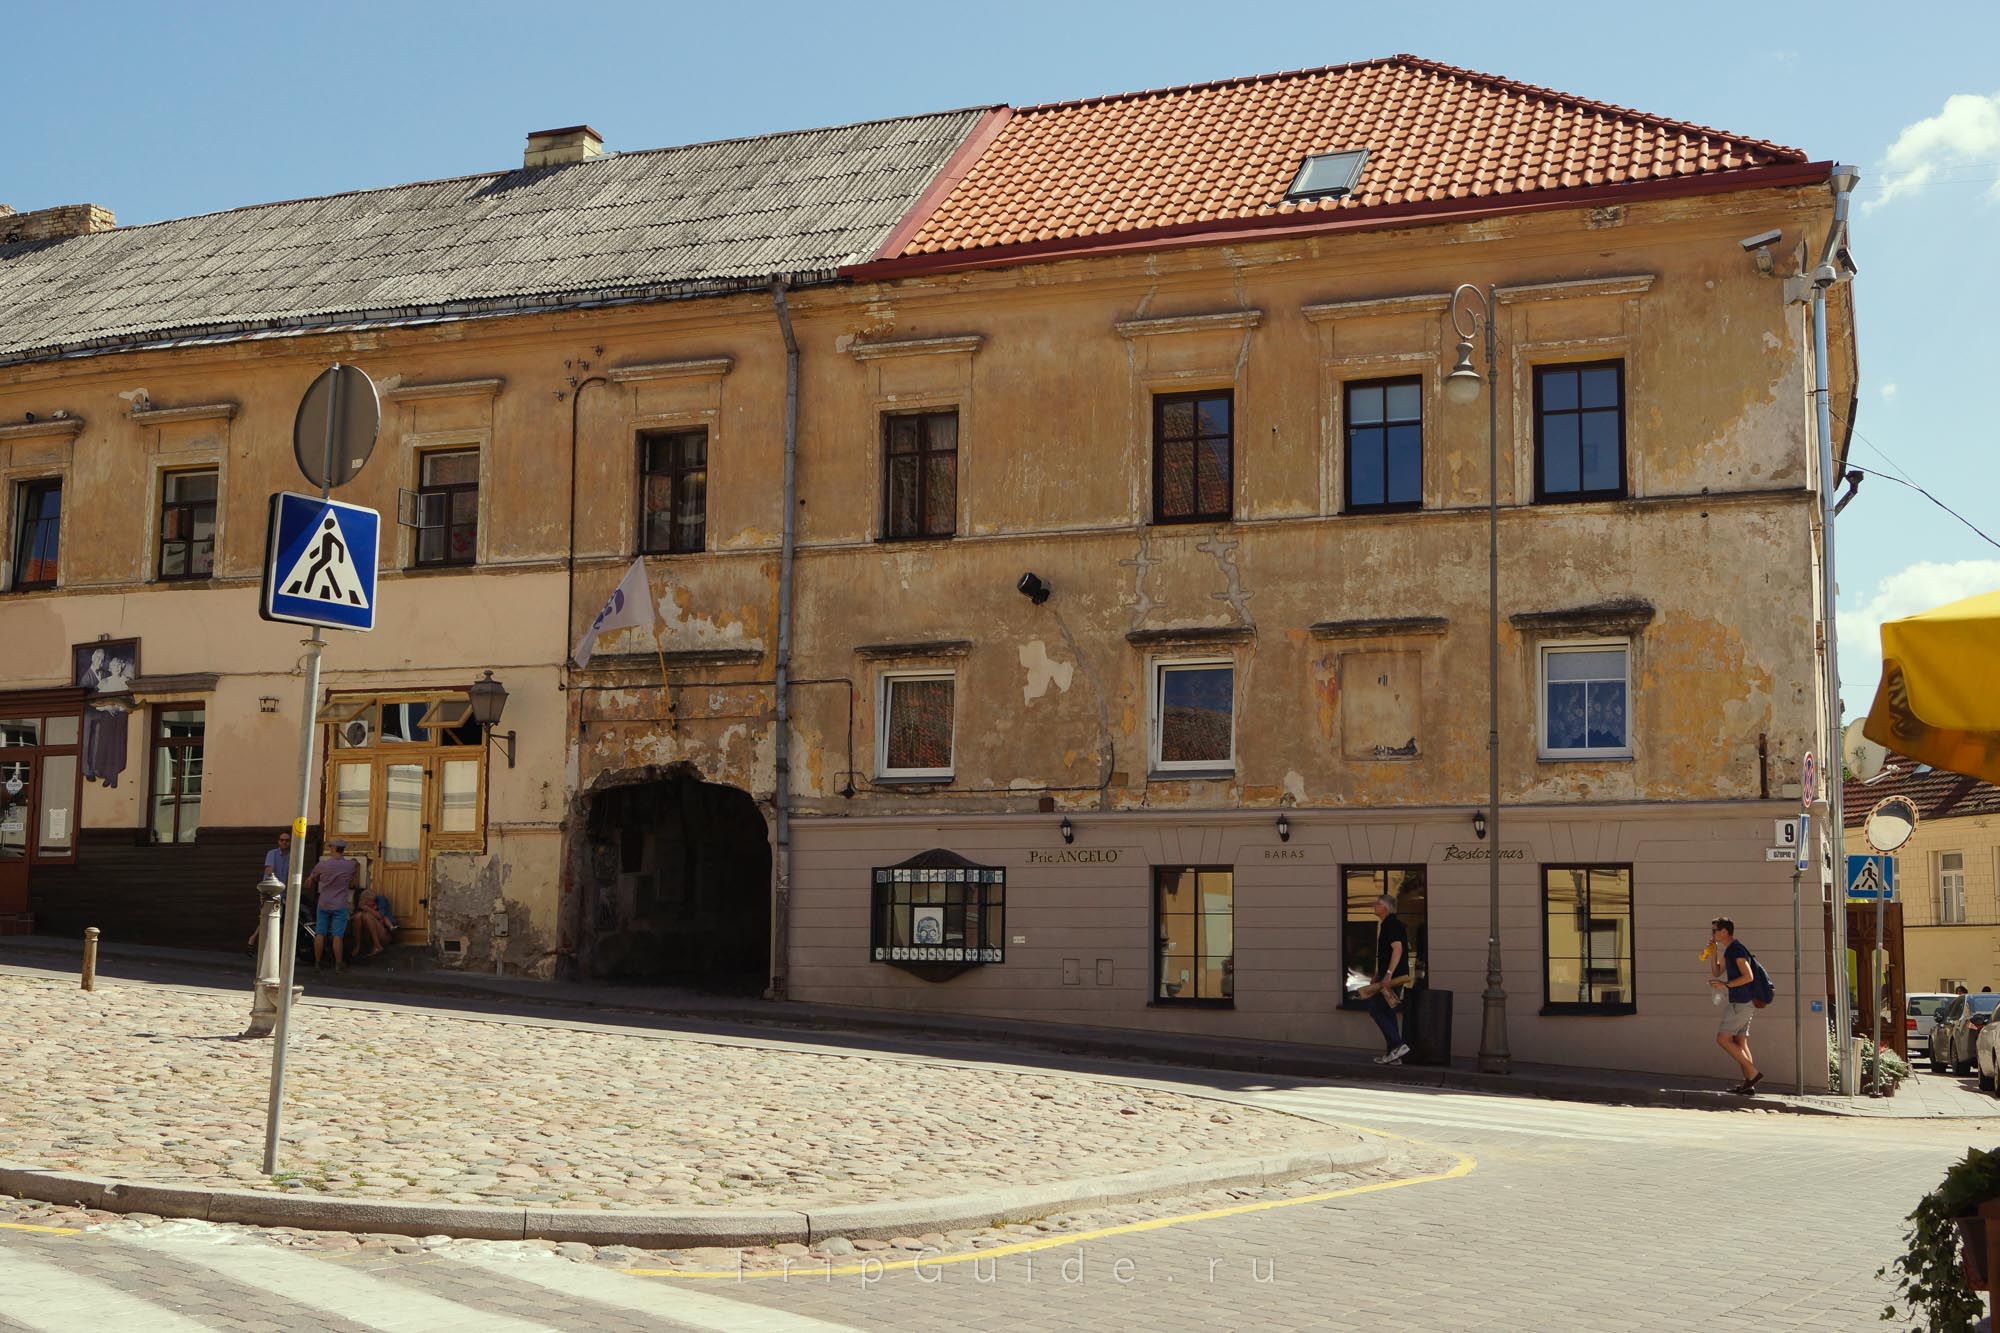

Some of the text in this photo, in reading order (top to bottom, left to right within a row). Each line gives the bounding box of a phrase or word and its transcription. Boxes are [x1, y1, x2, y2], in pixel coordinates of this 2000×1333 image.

[1785, 823, 1794, 843] 9
[1264, 850, 1305, 859] BARAS
[1443, 844, 1524, 861] Restornas
